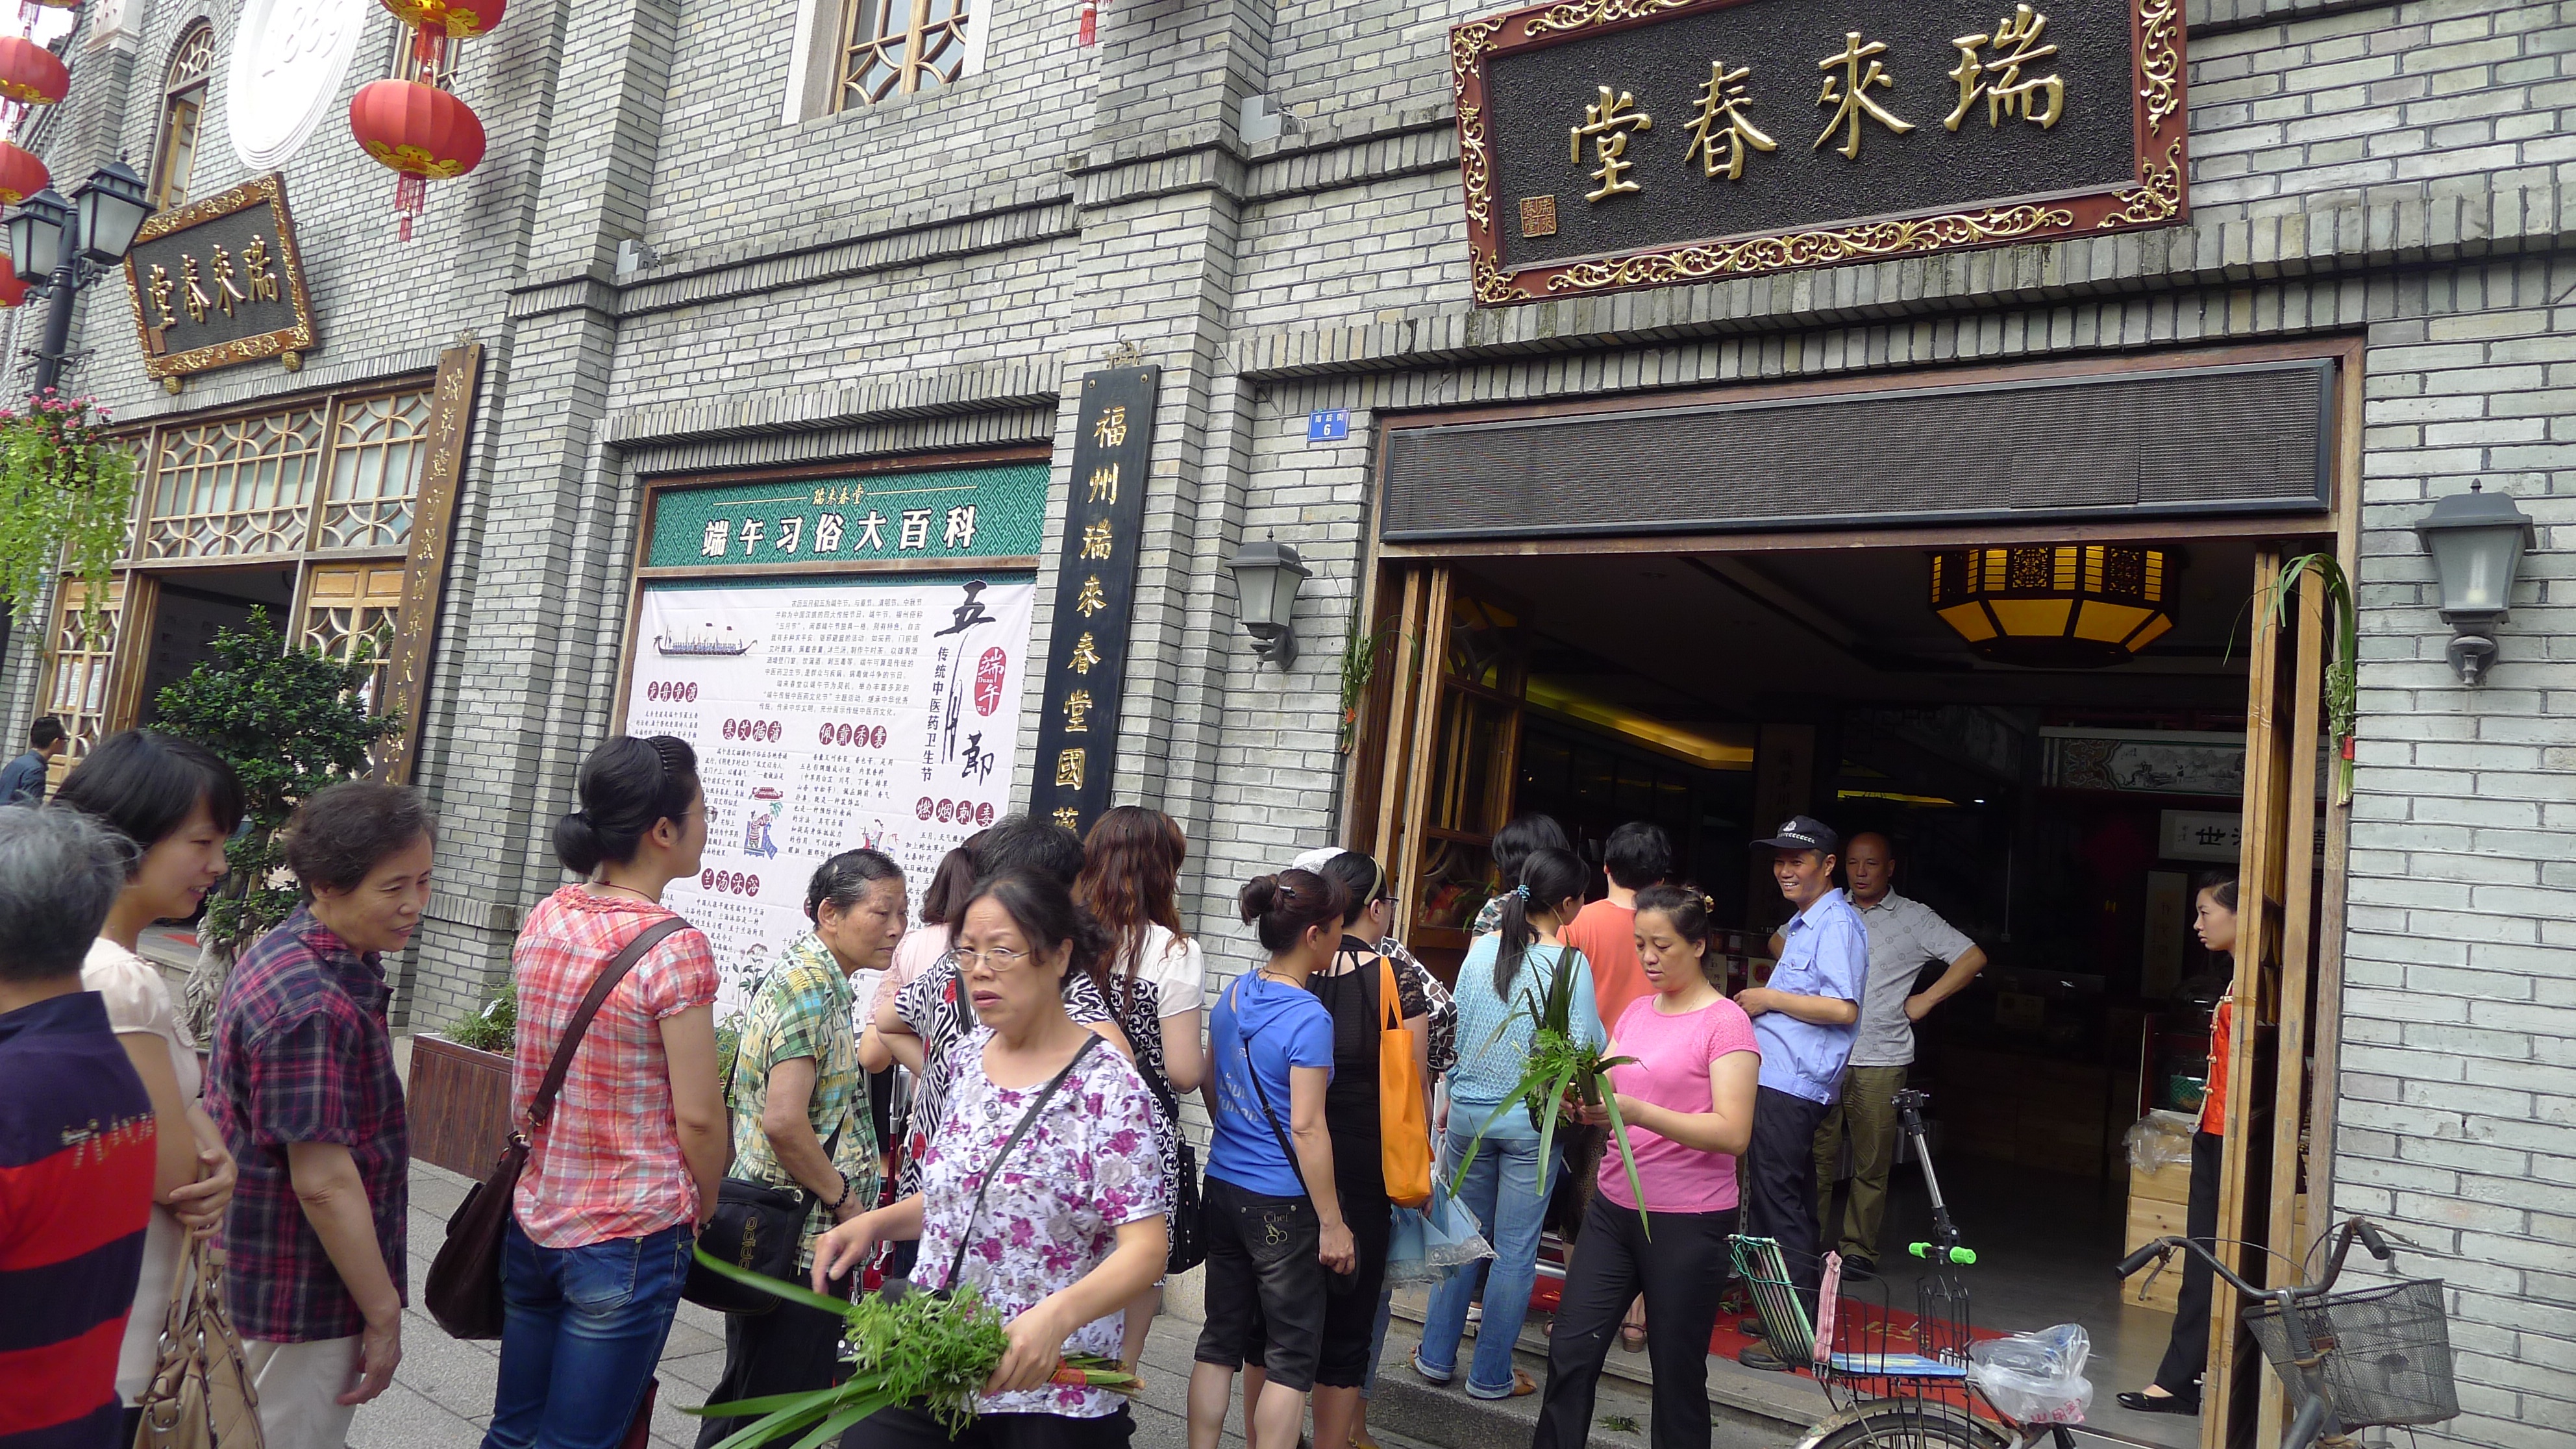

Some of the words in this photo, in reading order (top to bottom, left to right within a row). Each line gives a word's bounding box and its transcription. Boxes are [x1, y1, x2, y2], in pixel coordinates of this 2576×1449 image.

[1569, 3, 2065, 203] 瑞來春堂
[1315, 413, 1344, 424] 南后街
[1323, 424, 1331, 436] 6
[701, 504, 978, 557] 端午习俗大百科
[978, 648, 1005, 715] 端午
[920, 646, 949, 783] 传统中医药卫生节
[723, 719, 782, 742] 悬艾插蒲
[819, 723, 887, 748] 佩戴香囊
[916, 797, 994, 827] 燃烟刺毒
[701, 868, 760, 897] 兰汤沐浴
[737, 1216, 758, 1271] adida
